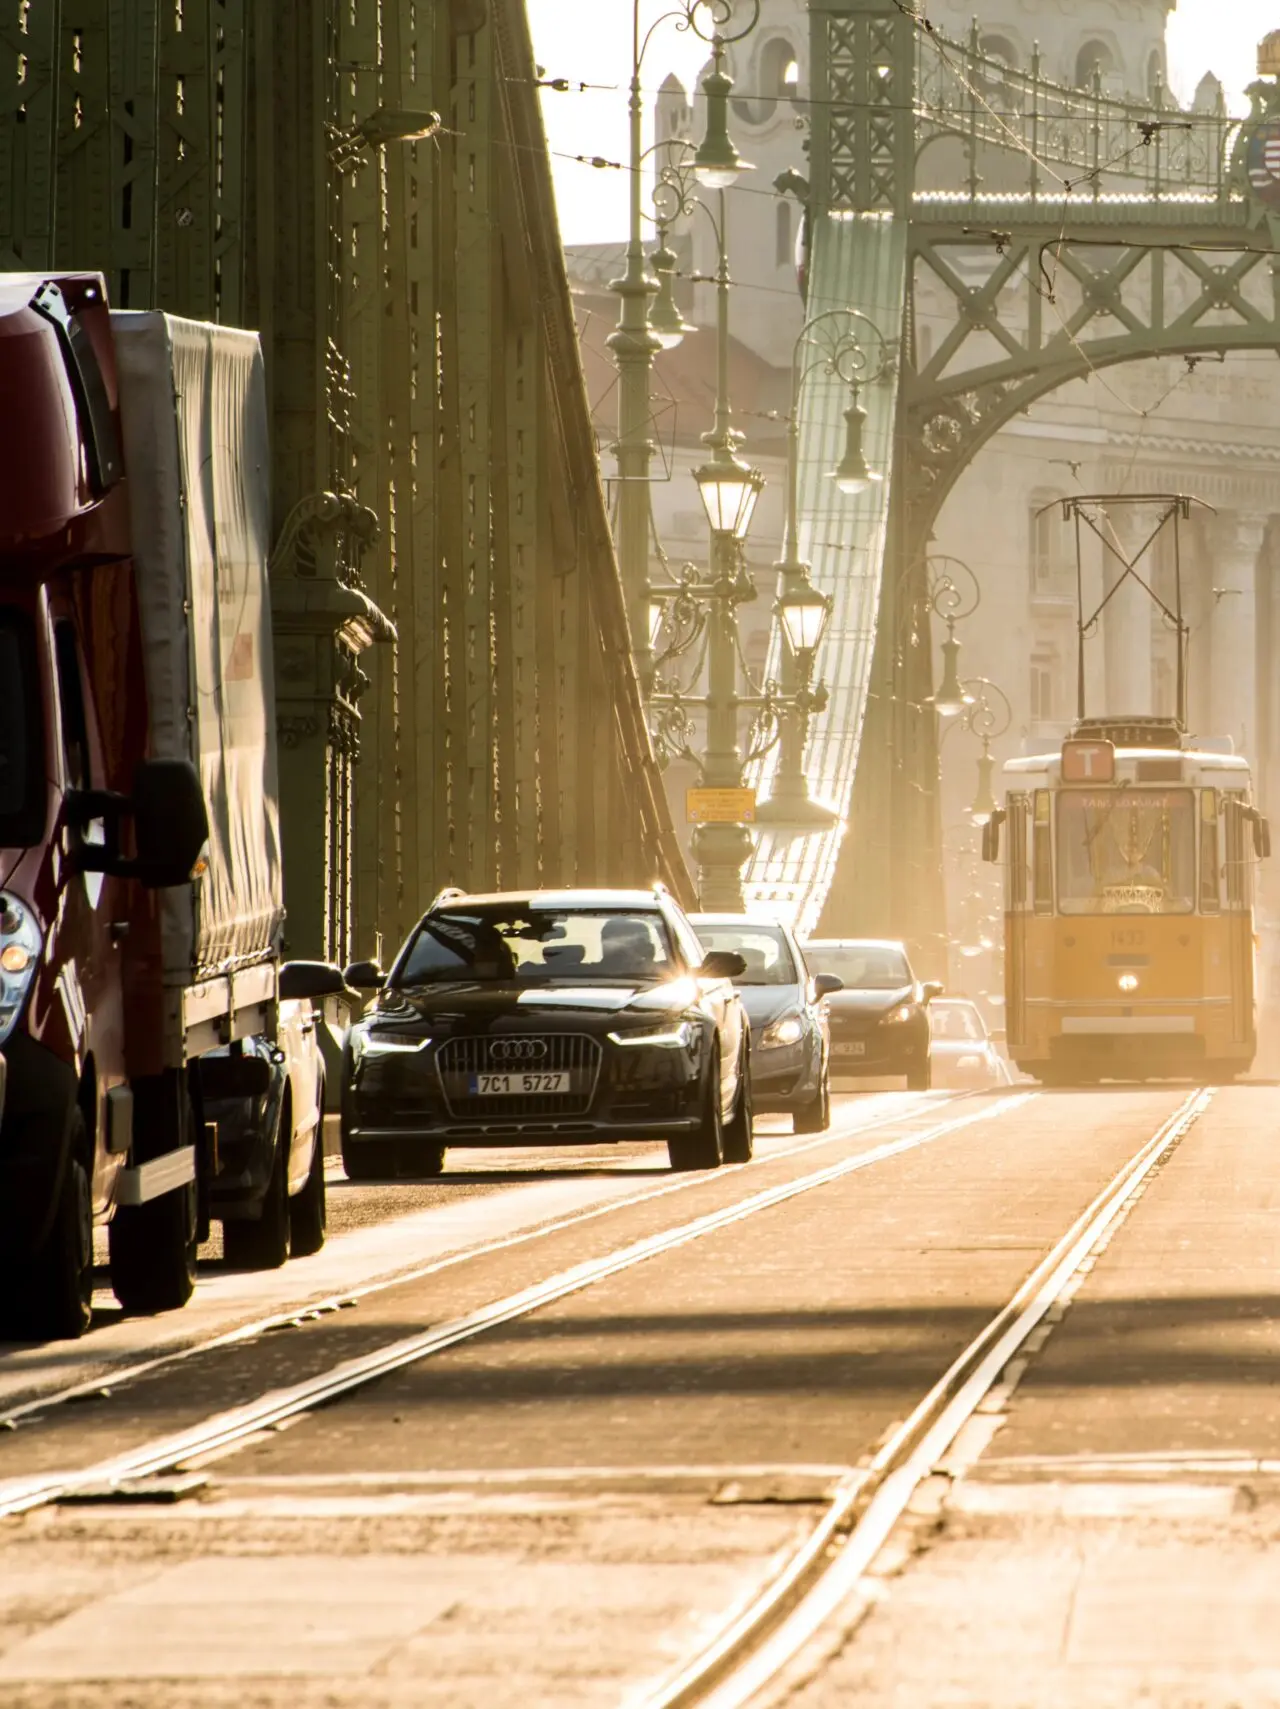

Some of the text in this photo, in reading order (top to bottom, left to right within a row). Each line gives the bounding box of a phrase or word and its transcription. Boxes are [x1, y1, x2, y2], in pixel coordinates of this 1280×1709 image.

[1076, 748, 1100, 776] T
[481, 1074, 562, 1093] 7C1 5727
